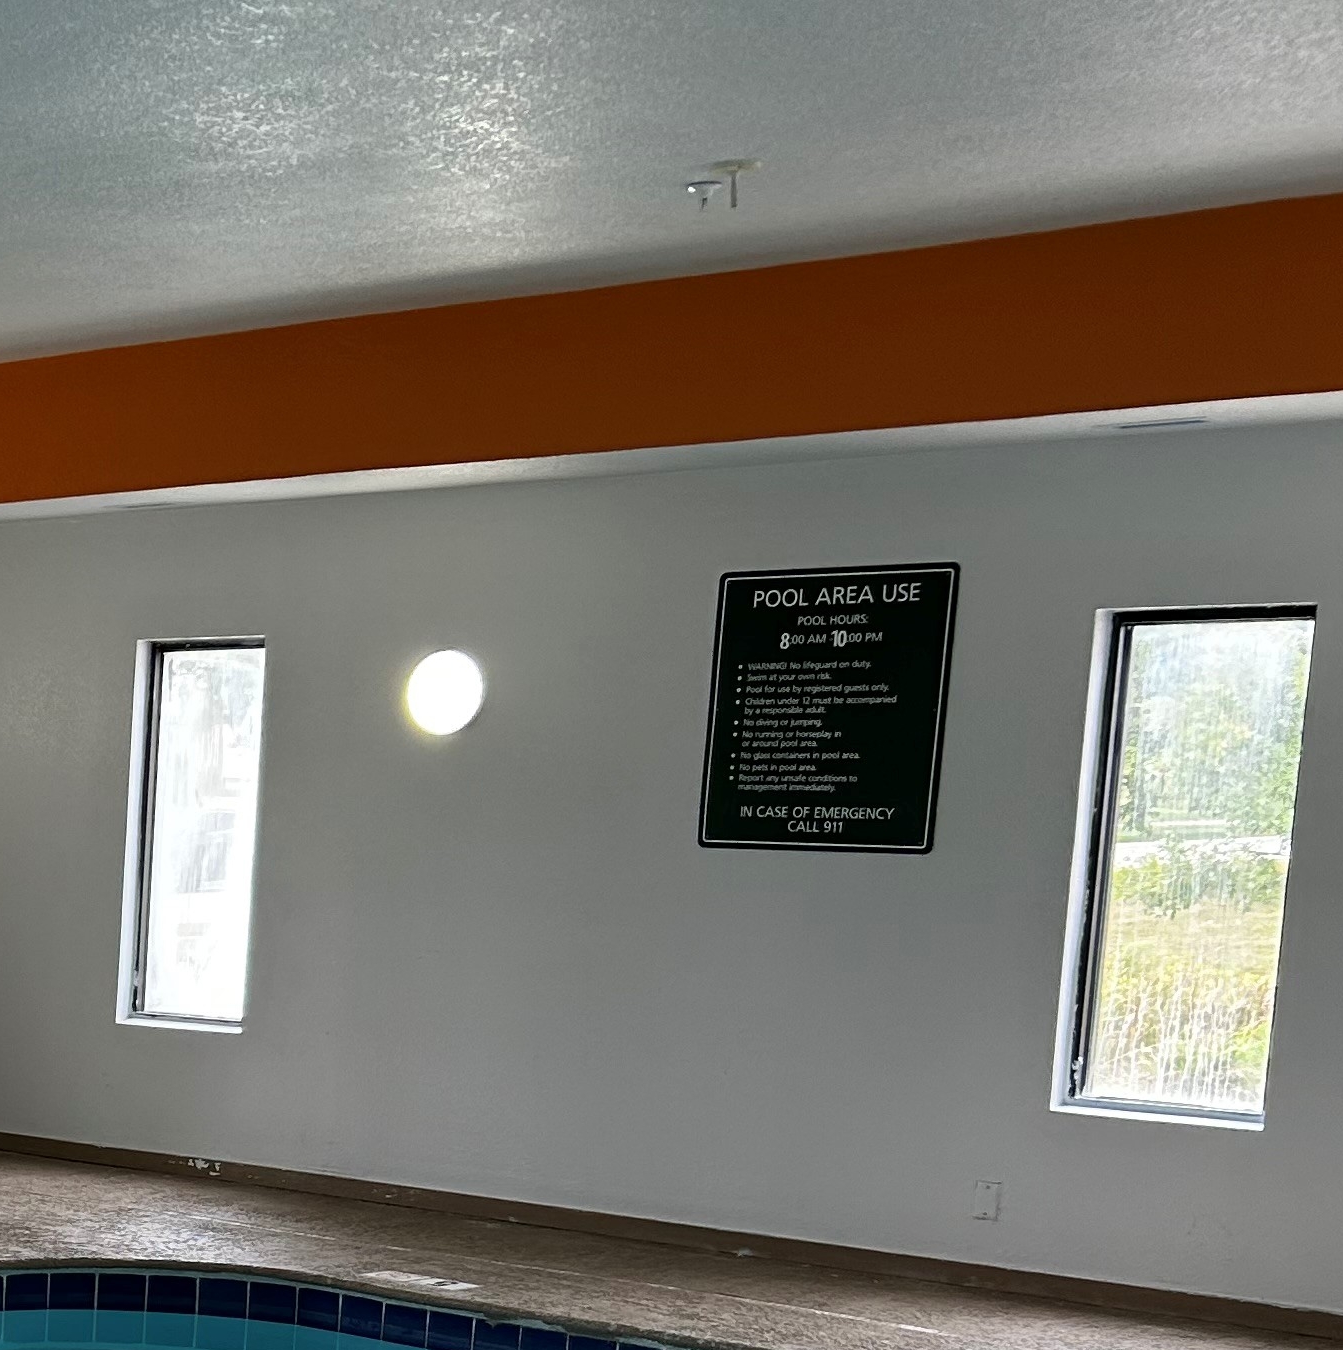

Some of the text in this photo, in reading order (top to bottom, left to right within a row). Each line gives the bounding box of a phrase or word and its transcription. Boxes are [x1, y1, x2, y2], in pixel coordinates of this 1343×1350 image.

[753, 582, 922, 608] POOL AREA USE
[797, 613, 869, 626] POOL HOURS:
[779, 632, 805, 649] 8:00
[807, 633, 827, 644] AM
[865, 632, 883, 642] PM
[740, 805, 896, 820] IN CASE OF EMERGENCY
[787, 820, 844, 833] CALL 911
